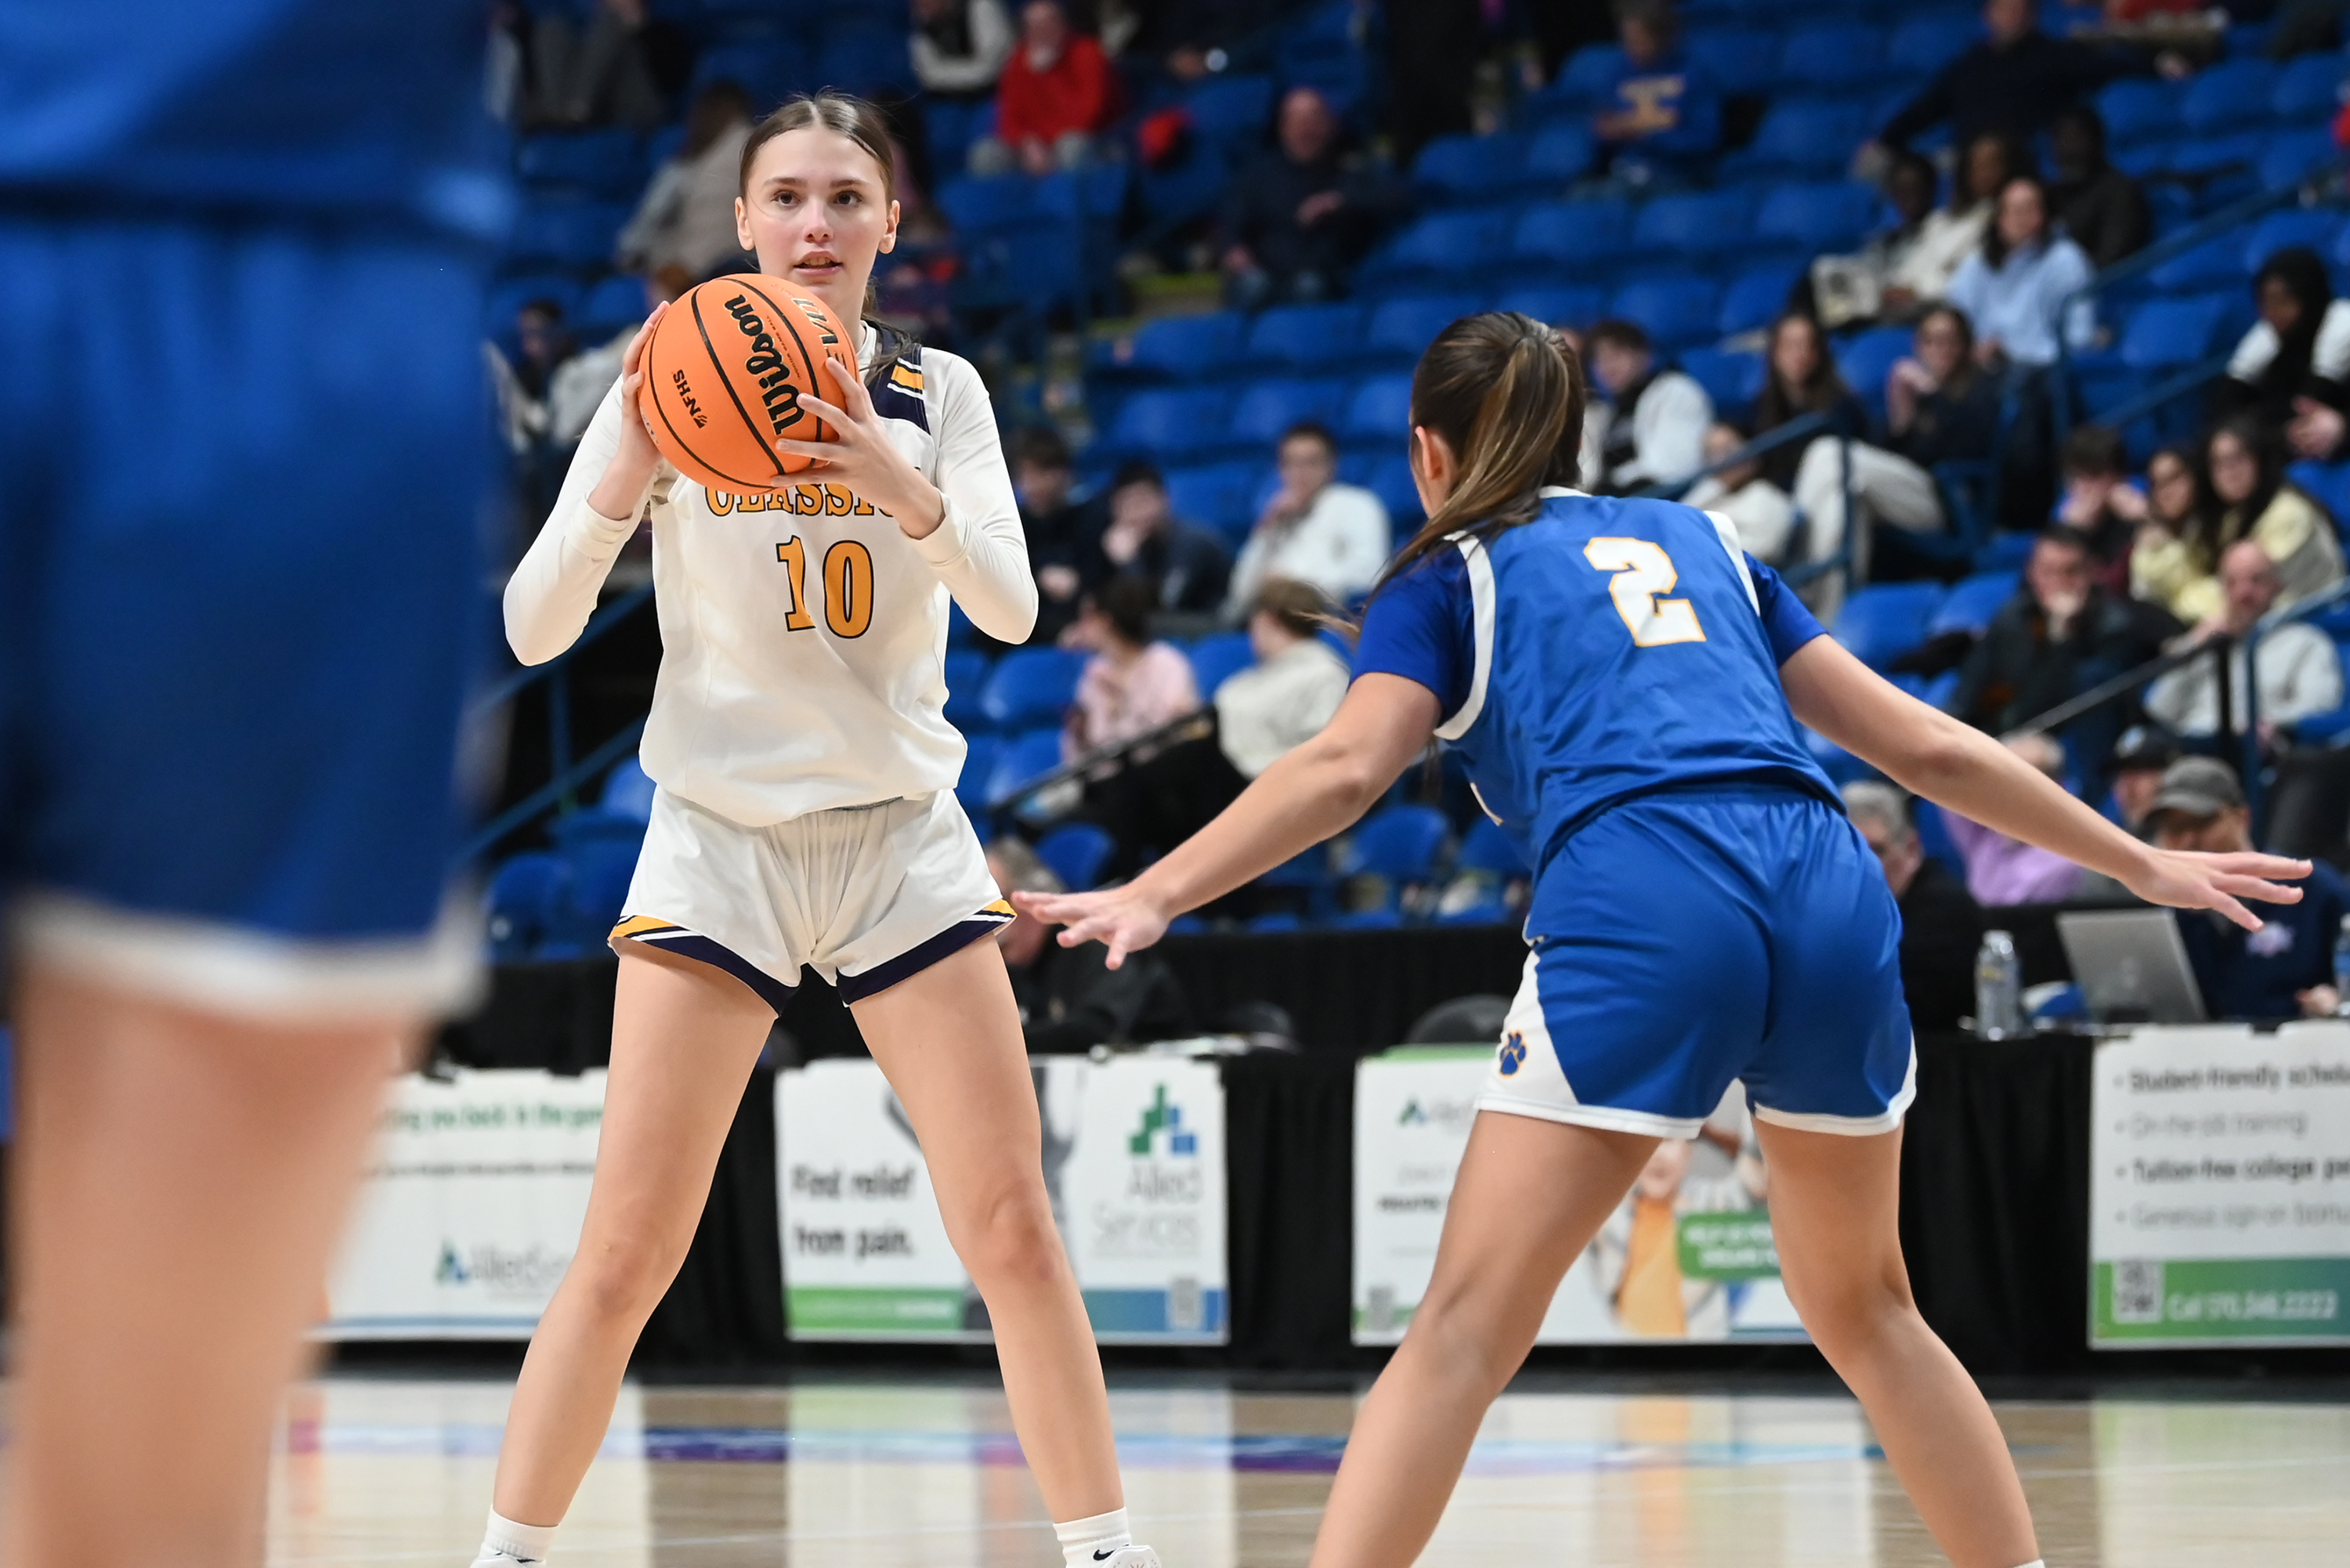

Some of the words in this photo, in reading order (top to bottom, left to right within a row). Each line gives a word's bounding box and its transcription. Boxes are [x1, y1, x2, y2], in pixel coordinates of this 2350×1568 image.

[672, 369, 702, 417] NFHS
[724, 294, 805, 435] Wilson
[776, 535, 874, 639] 10
[1583, 537, 1707, 647] 2
[851, 1160, 917, 1200] relief
